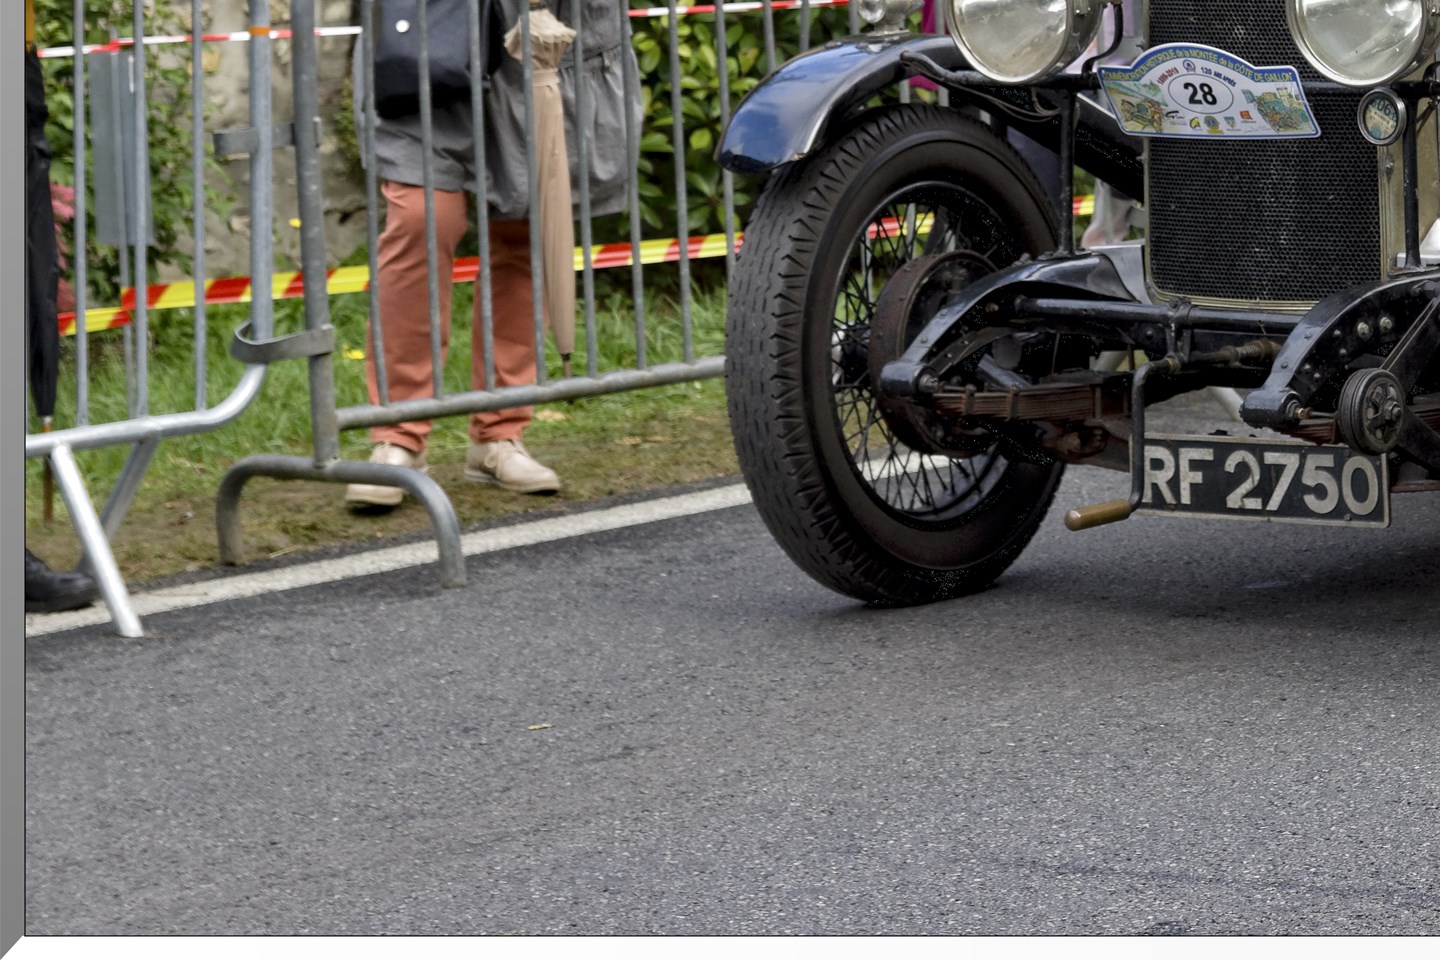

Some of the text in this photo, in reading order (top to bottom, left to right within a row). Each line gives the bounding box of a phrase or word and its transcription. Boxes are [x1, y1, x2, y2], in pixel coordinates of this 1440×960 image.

[1145, 50, 1177, 72] HISTORIQUE
[1190, 49, 1218, 64] MONTÉE
[1219, 57, 1227, 66] de
[1234, 63, 1253, 80] CÔTE
[1254, 73, 1265, 82] DE
[1264, 72, 1293, 81] GAILLON
[1201, 66, 1212, 76] 120
[1183, 82, 1218, 107] 28
[1142, 445, 1379, 516] RF 2750
